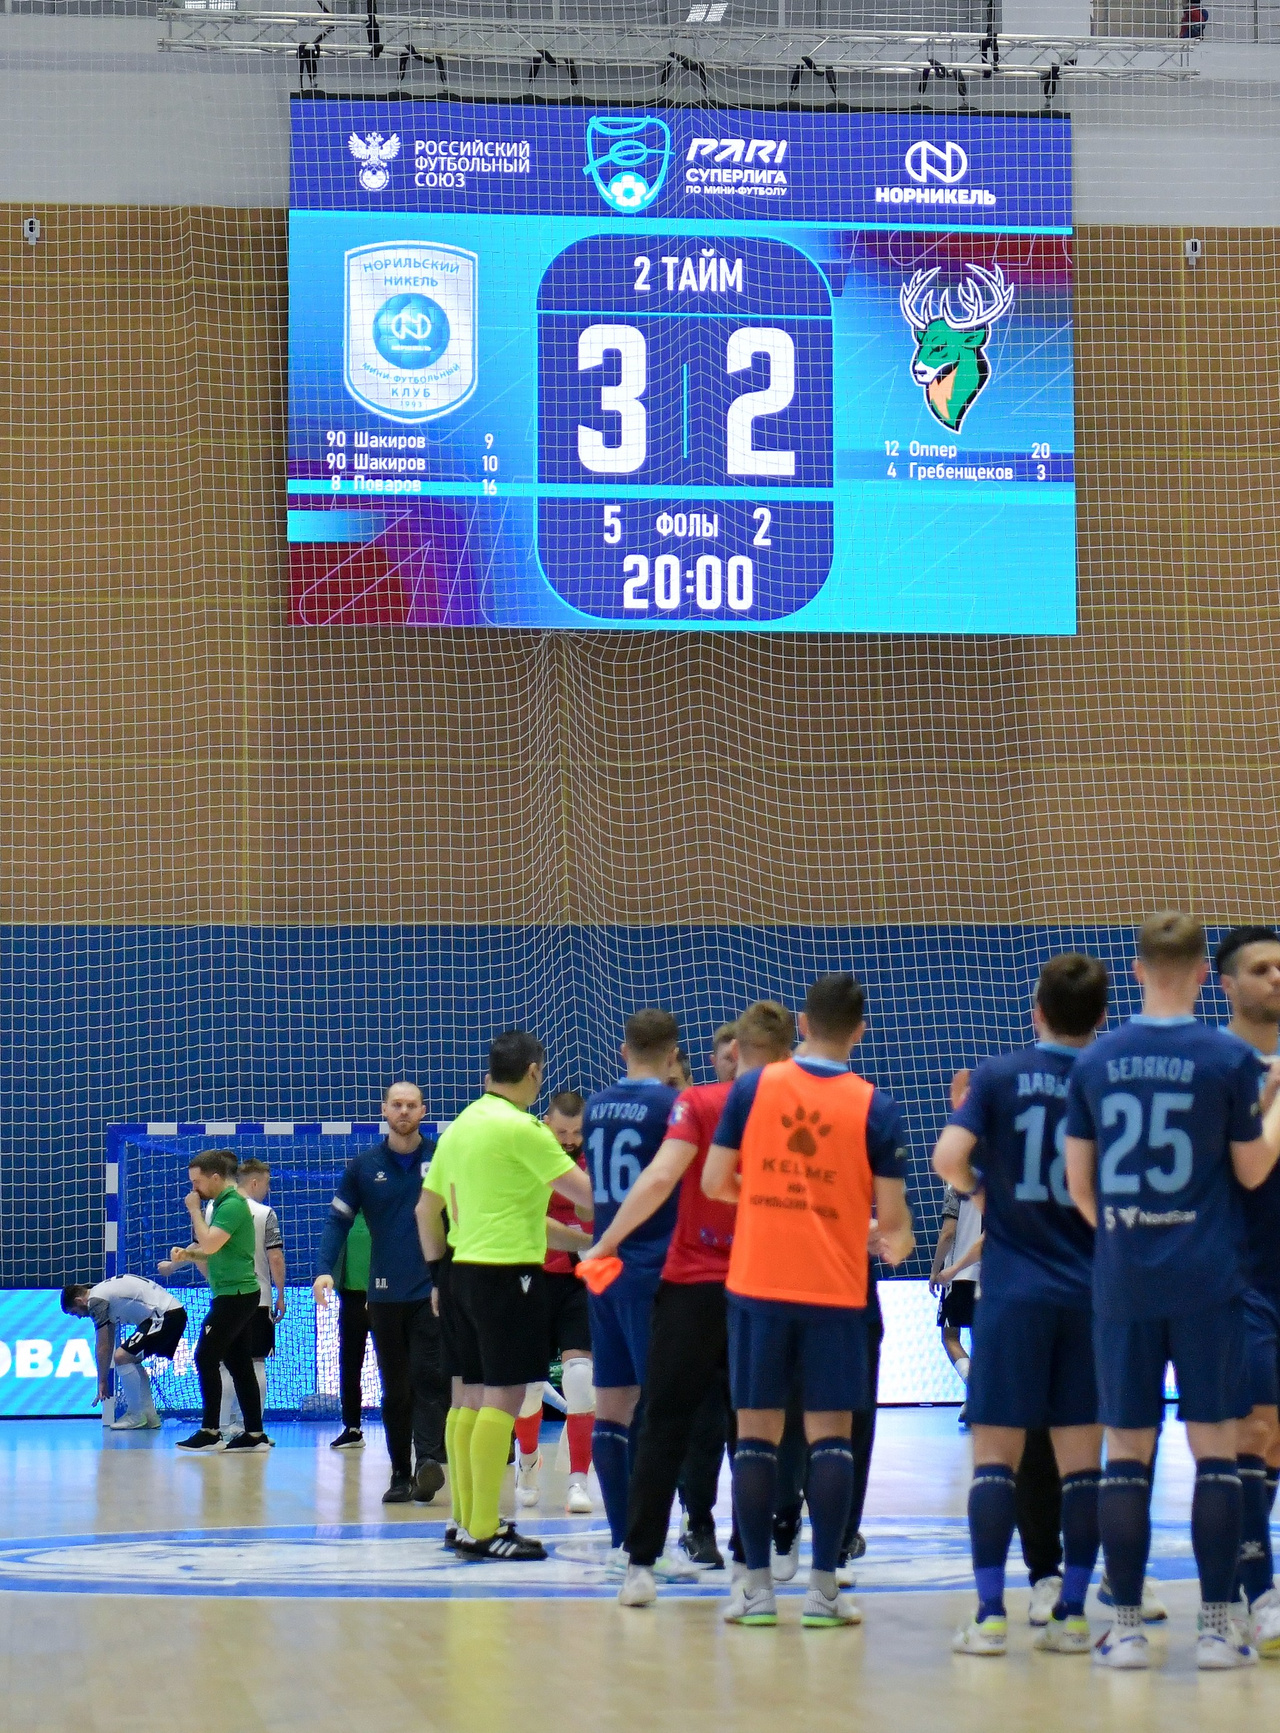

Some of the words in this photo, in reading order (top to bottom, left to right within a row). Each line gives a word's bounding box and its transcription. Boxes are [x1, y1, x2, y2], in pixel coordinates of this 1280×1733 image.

[414, 139, 531, 158] РОССИЙСКИЙ
[686, 138, 787, 163] PARI
[414, 152, 531, 174] ФУТБОЛЬНЫЙ
[414, 172, 466, 188] СОЮЗ
[686, 168, 787, 184] СУПЕРЛИГА
[686, 186, 701, 194] ПО
[704, 186, 787, 195] МИНИ-ФУТБОЛУ
[875, 187, 996, 206] НОРНИКЕЛЬ
[363, 257, 461, 275] НОРИЛЬСКИЙ
[634, 256, 651, 291] 2
[662, 249, 743, 292] ТАЙМ
[384, 276, 439, 287] НИКЕЛЬ
[392, 387, 431, 398] КЛУБ
[578, 324, 647, 473] 3
[727, 327, 796, 476] 2
[327, 430, 346, 448] 90
[354, 431, 426, 450] Шакиров
[484, 433, 494, 450] 9
[884, 441, 899, 457] 12
[909, 440, 957, 459] Оппер
[1031, 443, 1050, 459] 20
[327, 453, 346, 470] 90
[354, 453, 426, 472] Шакиров
[483, 455, 498, 472] 10
[887, 463, 897, 478] 4
[909, 463, 1014, 481] Гребенщеков
[1036, 465, 1046, 481] 3
[331, 475, 341, 493] 8
[354, 475, 421, 494] Поваров
[483, 478, 498, 496] 16
[603, 505, 622, 544] 5
[656, 511, 718, 538] ФОЛЫ
[753, 507, 772, 546] 2
[623, 554, 753, 611] 20:00
[1107, 1055, 1194, 1084] БЕЛЯКОВ
[590, 1102, 648, 1122] КУТУЗОВ
[1102, 1092, 1195, 1195] 25
[588, 1127, 642, 1203] 16
